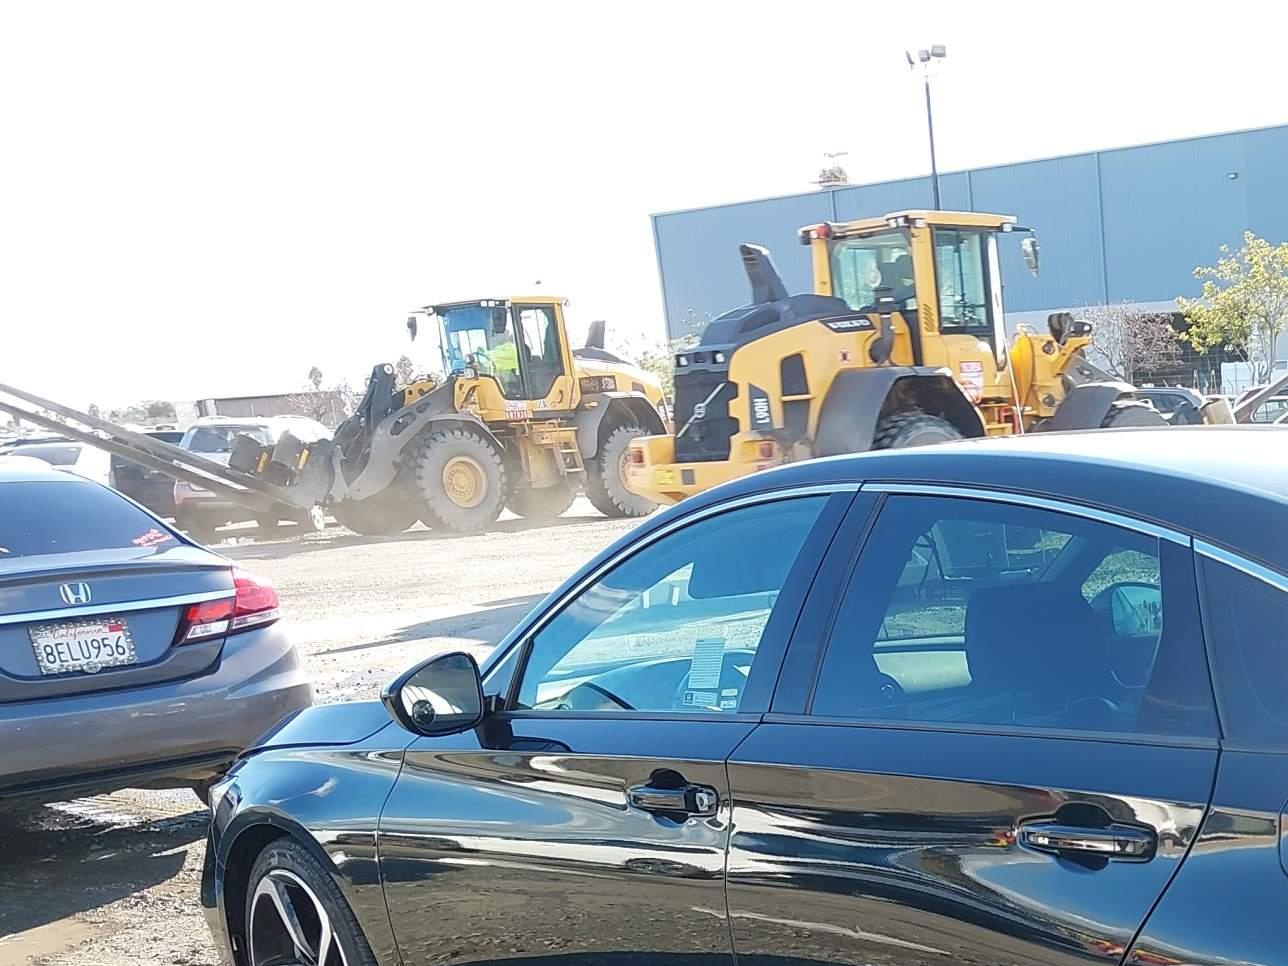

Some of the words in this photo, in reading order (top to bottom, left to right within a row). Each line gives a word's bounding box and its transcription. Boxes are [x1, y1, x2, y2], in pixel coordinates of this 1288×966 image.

[753, 398, 771, 424] L90H
[51, 628, 104, 640] California
[42, 635, 127, 665] 8ELU956
